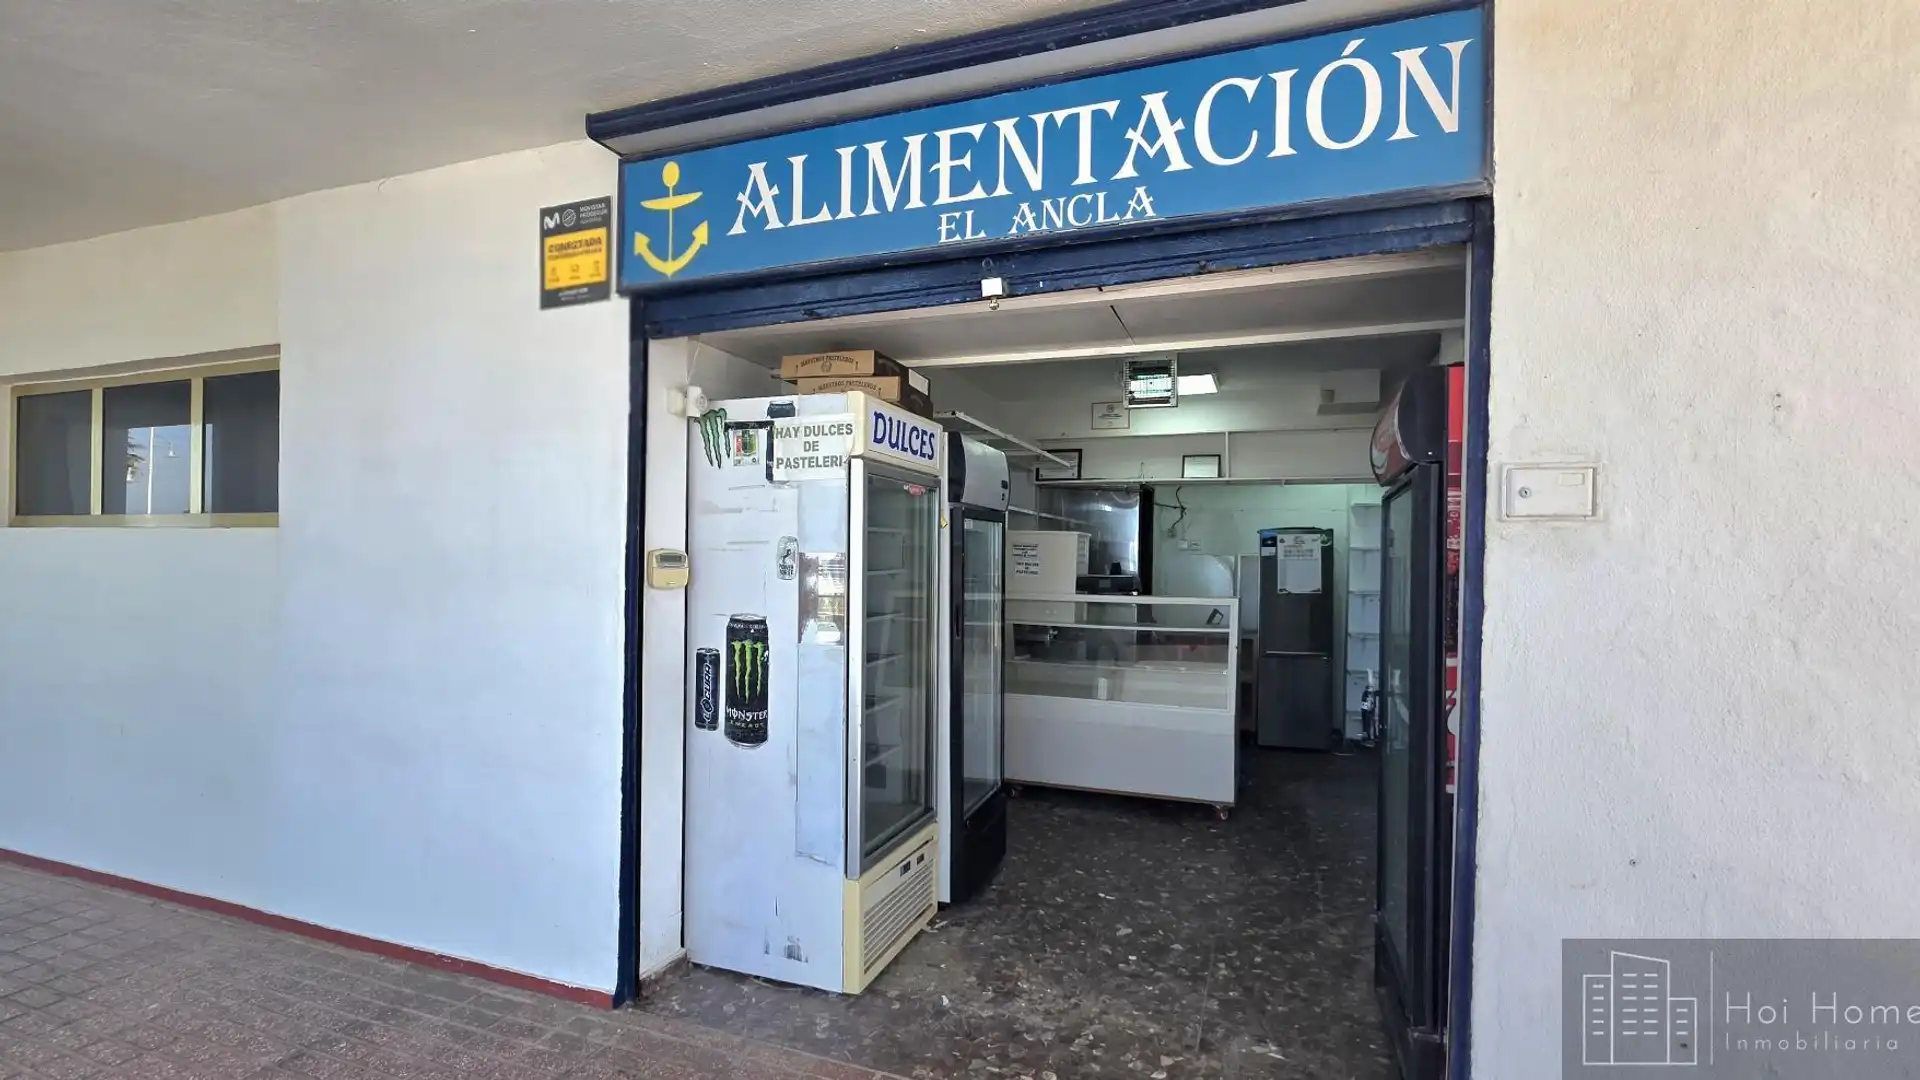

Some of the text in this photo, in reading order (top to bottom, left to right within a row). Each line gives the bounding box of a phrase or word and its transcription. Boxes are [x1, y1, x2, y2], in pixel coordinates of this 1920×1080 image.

[726, 38, 1474, 236] ALIMENTACIÓN
[937, 186, 1158, 243] EL ANCLA
[775, 423, 853, 439] HAY DULCES
[803, 441, 819, 452] DE
[873, 411, 935, 460] DULCES
[726, 705, 768, 722] MONSTER
